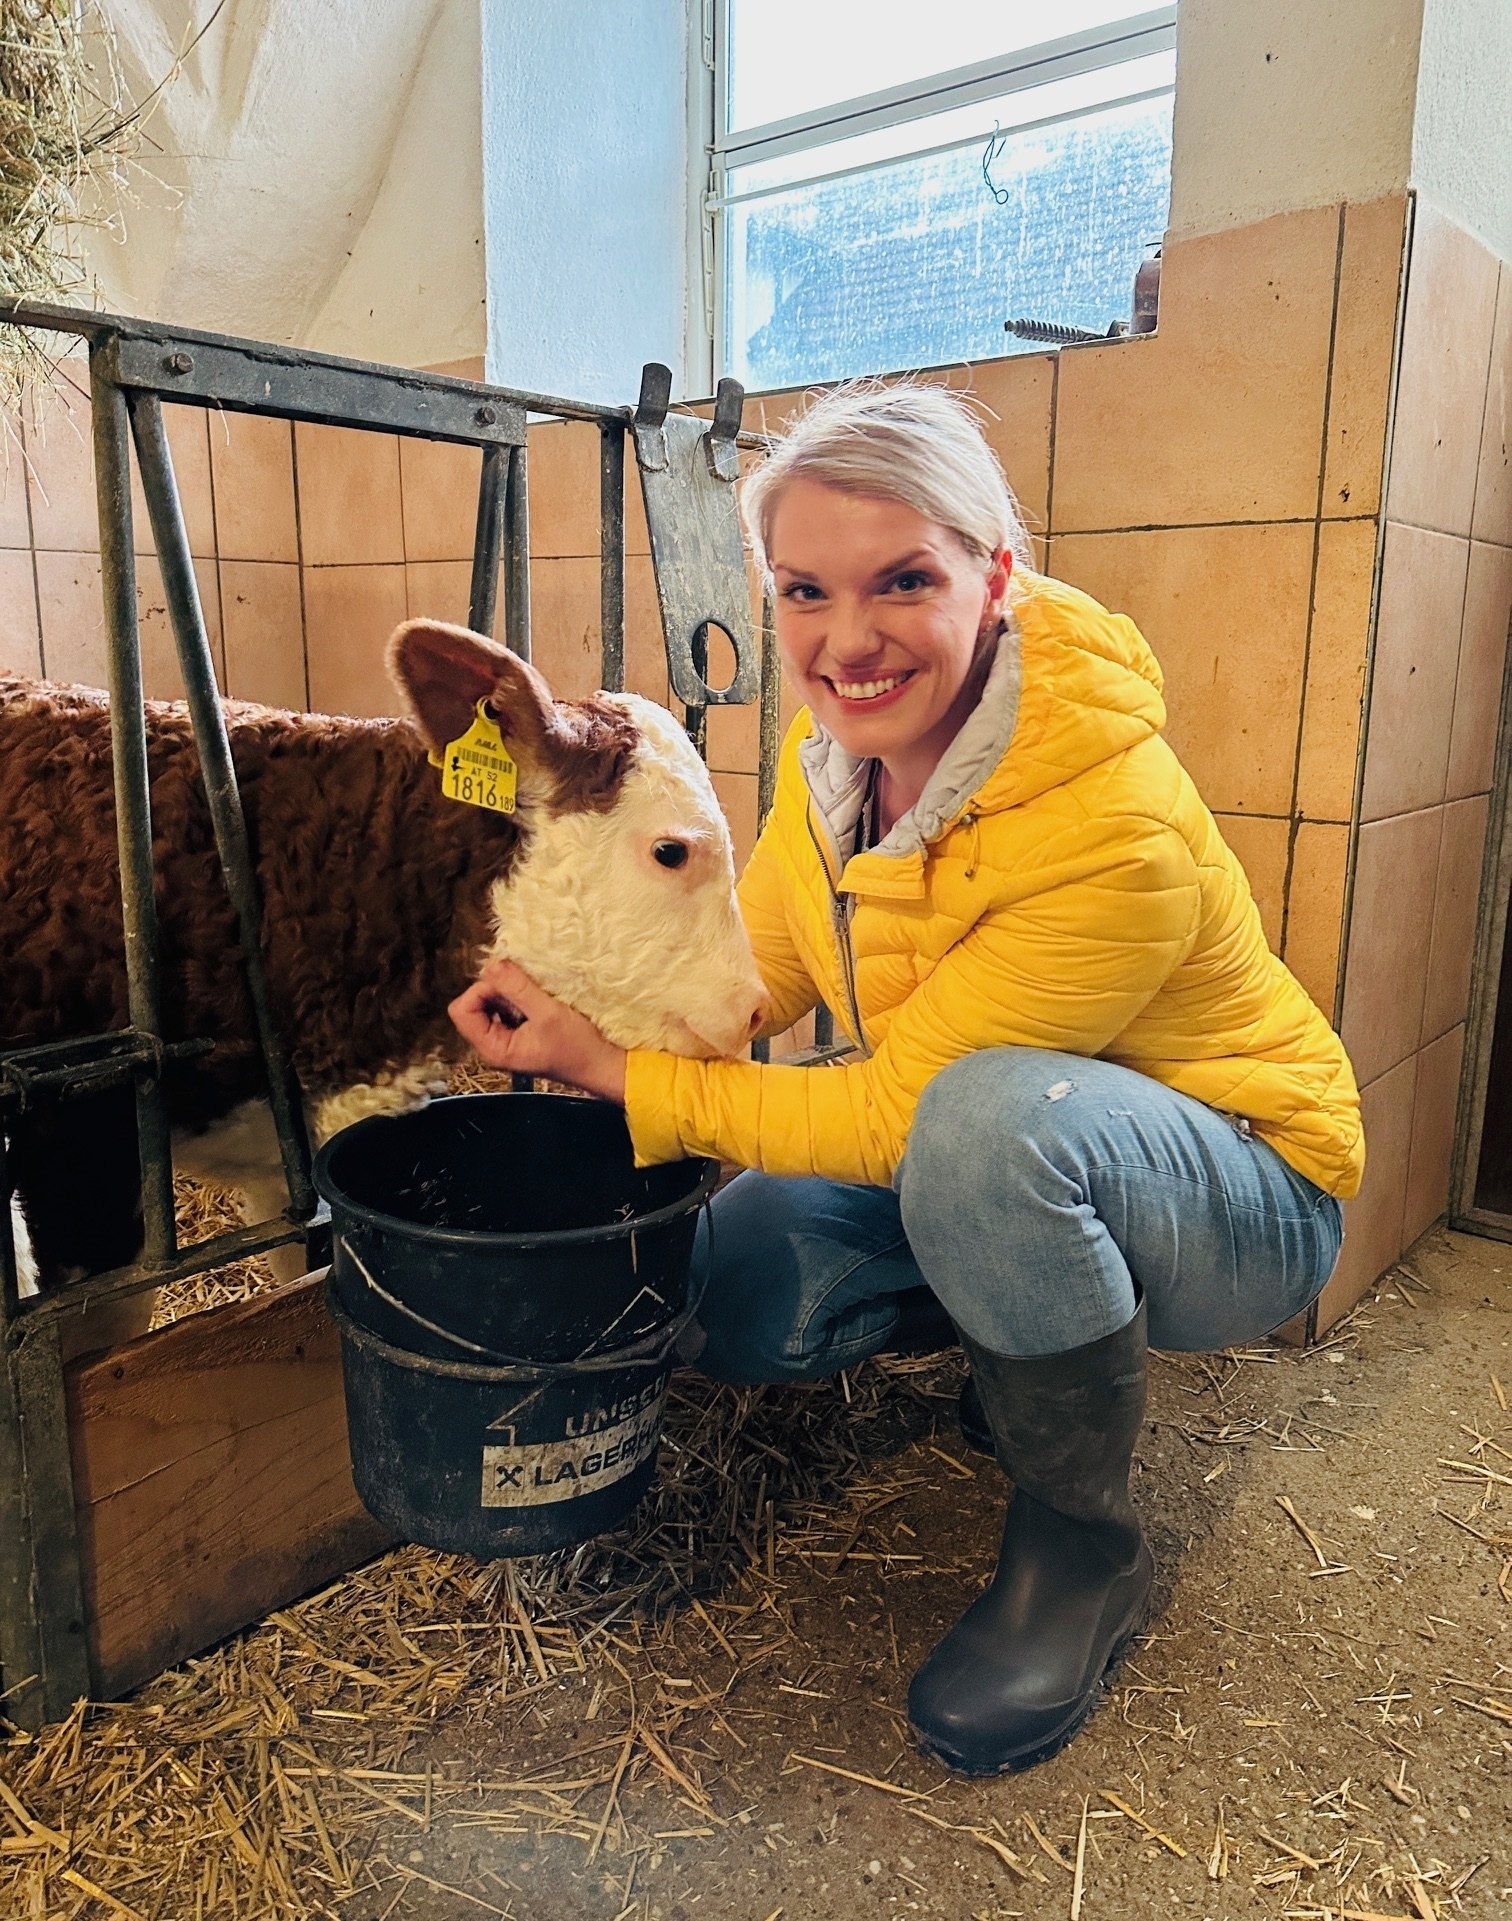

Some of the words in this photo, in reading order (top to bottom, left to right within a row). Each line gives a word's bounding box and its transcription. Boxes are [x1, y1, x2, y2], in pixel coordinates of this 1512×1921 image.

[471, 767, 481, 777] AT
[486, 771, 498, 782] 52
[452, 773, 497, 807] 1816
[499, 795, 514, 812] 189
